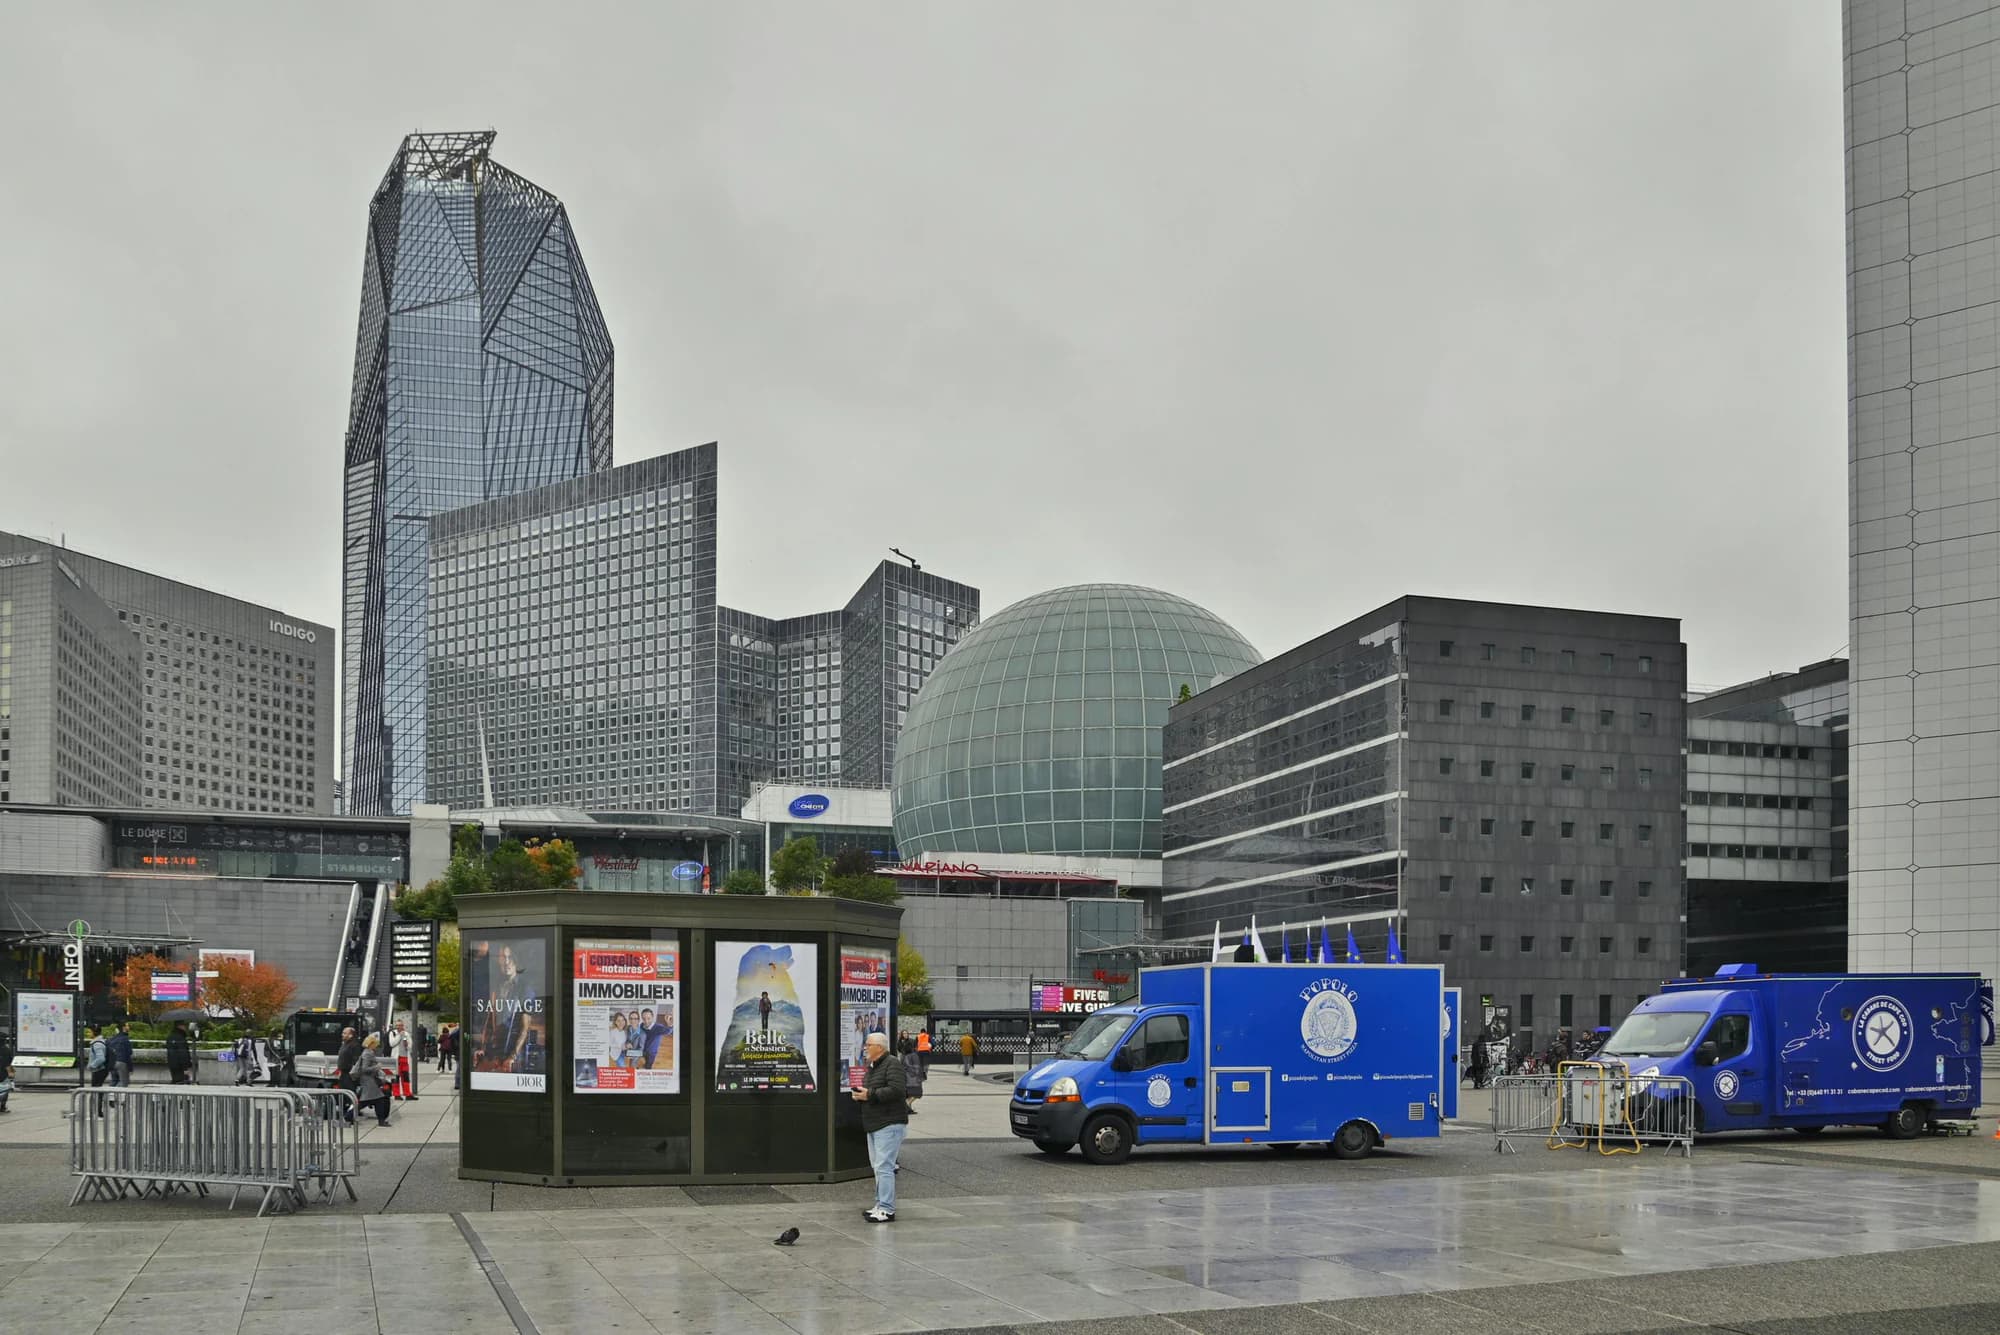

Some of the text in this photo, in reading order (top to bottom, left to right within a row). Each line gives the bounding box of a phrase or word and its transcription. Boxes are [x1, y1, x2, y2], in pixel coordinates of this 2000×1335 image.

[121, 827, 135, 838] LE
[327, 863, 393, 874] STARBUCKS
[64, 944, 80, 986] INFO
[589, 953, 641, 967] conseils
[602, 964, 644, 975] notaires
[578, 982, 675, 1000] IMMOBILIER
[839, 986, 888, 1004] IMMOBILIER
[1073, 989, 1097, 1001] FIVE
[1299, 977, 1358, 1003] POPOLO
[477, 999, 543, 1013] SAUVAGE
[1062, 1002, 1083, 1013] IVE
[1887, 1002, 1902, 1015] CAPE
[745, 1029, 786, 1045] Belle
[1866, 1051, 1885, 1064] STREET
[516, 1075, 544, 1088] DIOR
